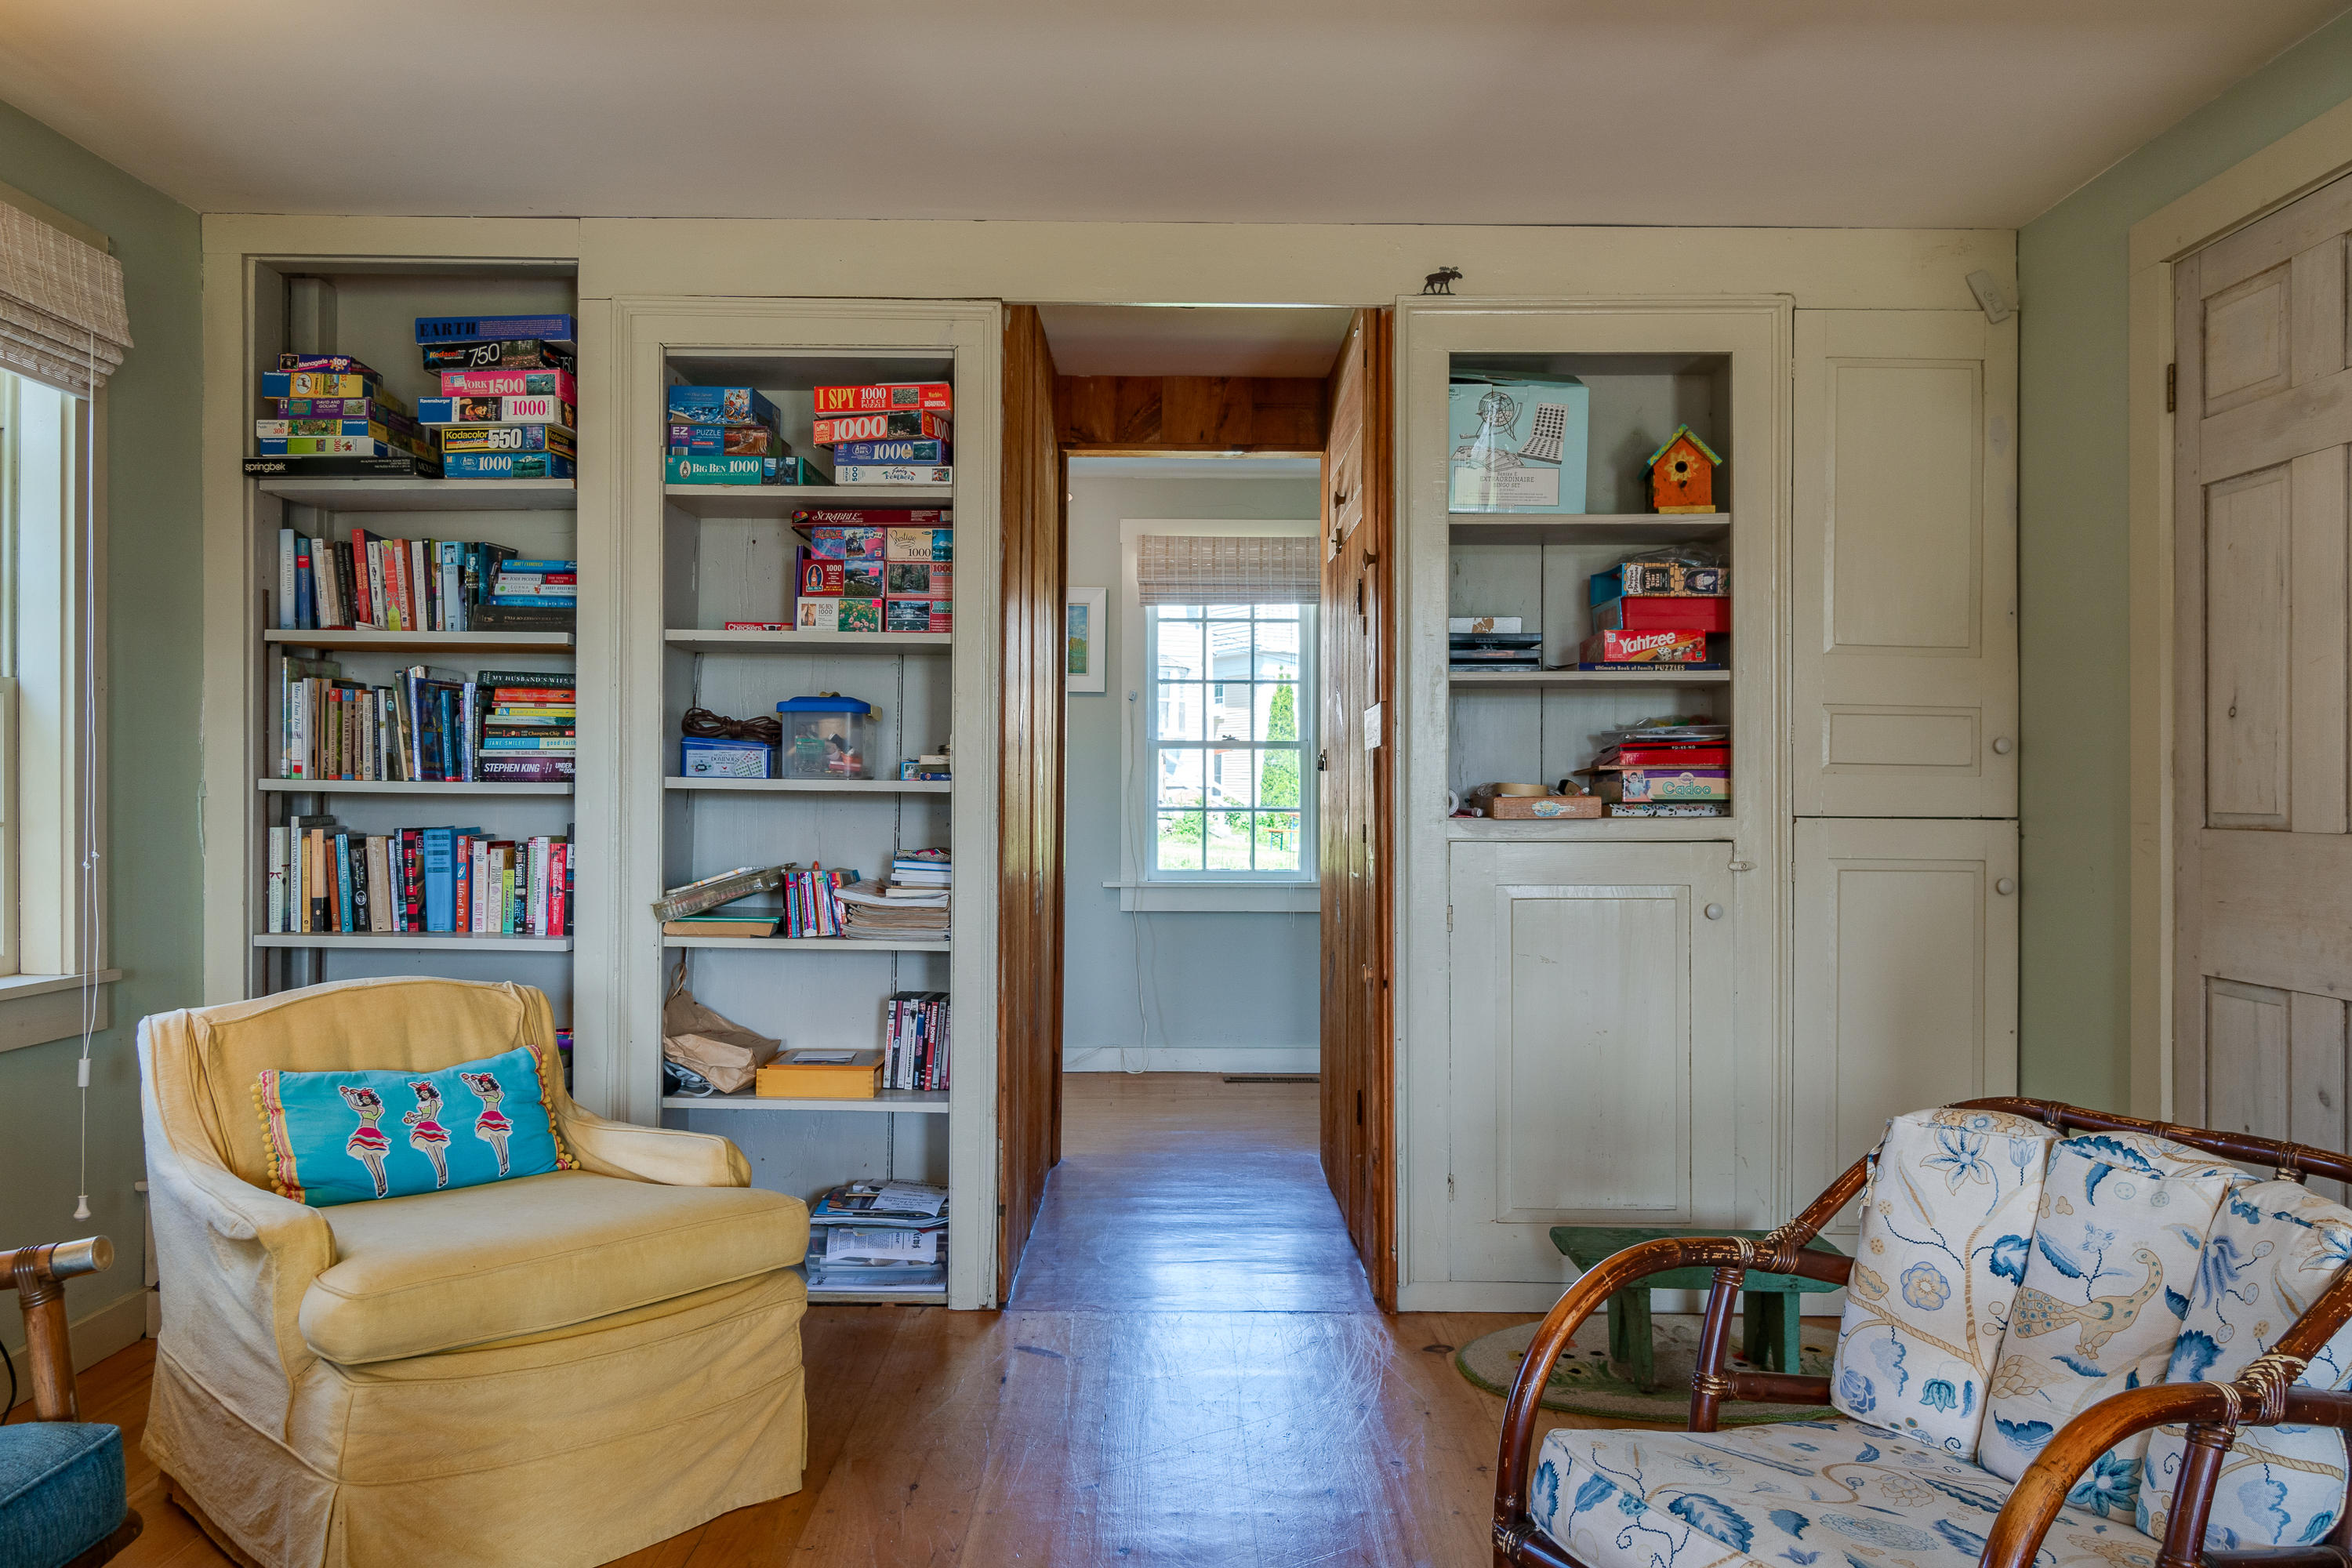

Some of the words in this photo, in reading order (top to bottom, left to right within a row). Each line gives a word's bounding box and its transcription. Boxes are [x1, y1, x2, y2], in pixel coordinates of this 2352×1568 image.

[420, 322, 476, 336] EARTH
[469, 343, 499, 367] 750
[299, 358, 328, 368] Menagerie
[561, 358, 573, 373] 750
[488, 379, 524, 394] 1500
[862, 388, 886, 399] 1000
[819, 390, 824, 408] I
[829, 389, 855, 409] SPY
[513, 401, 546, 416] 1000
[833, 416, 886, 440] 1000
[446, 430, 488, 439] Kodacolor
[488, 429, 521, 448] 550
[245, 463, 285, 472] springbok
[479, 456, 511, 470] 1000
[730, 460, 759, 473] 1000
[890, 530, 916, 544] Prestige
[1620, 632, 1675, 654] Yahtzee
[1662, 781, 1711, 795] Cadoo
[458, 908, 464, 916] Pi
